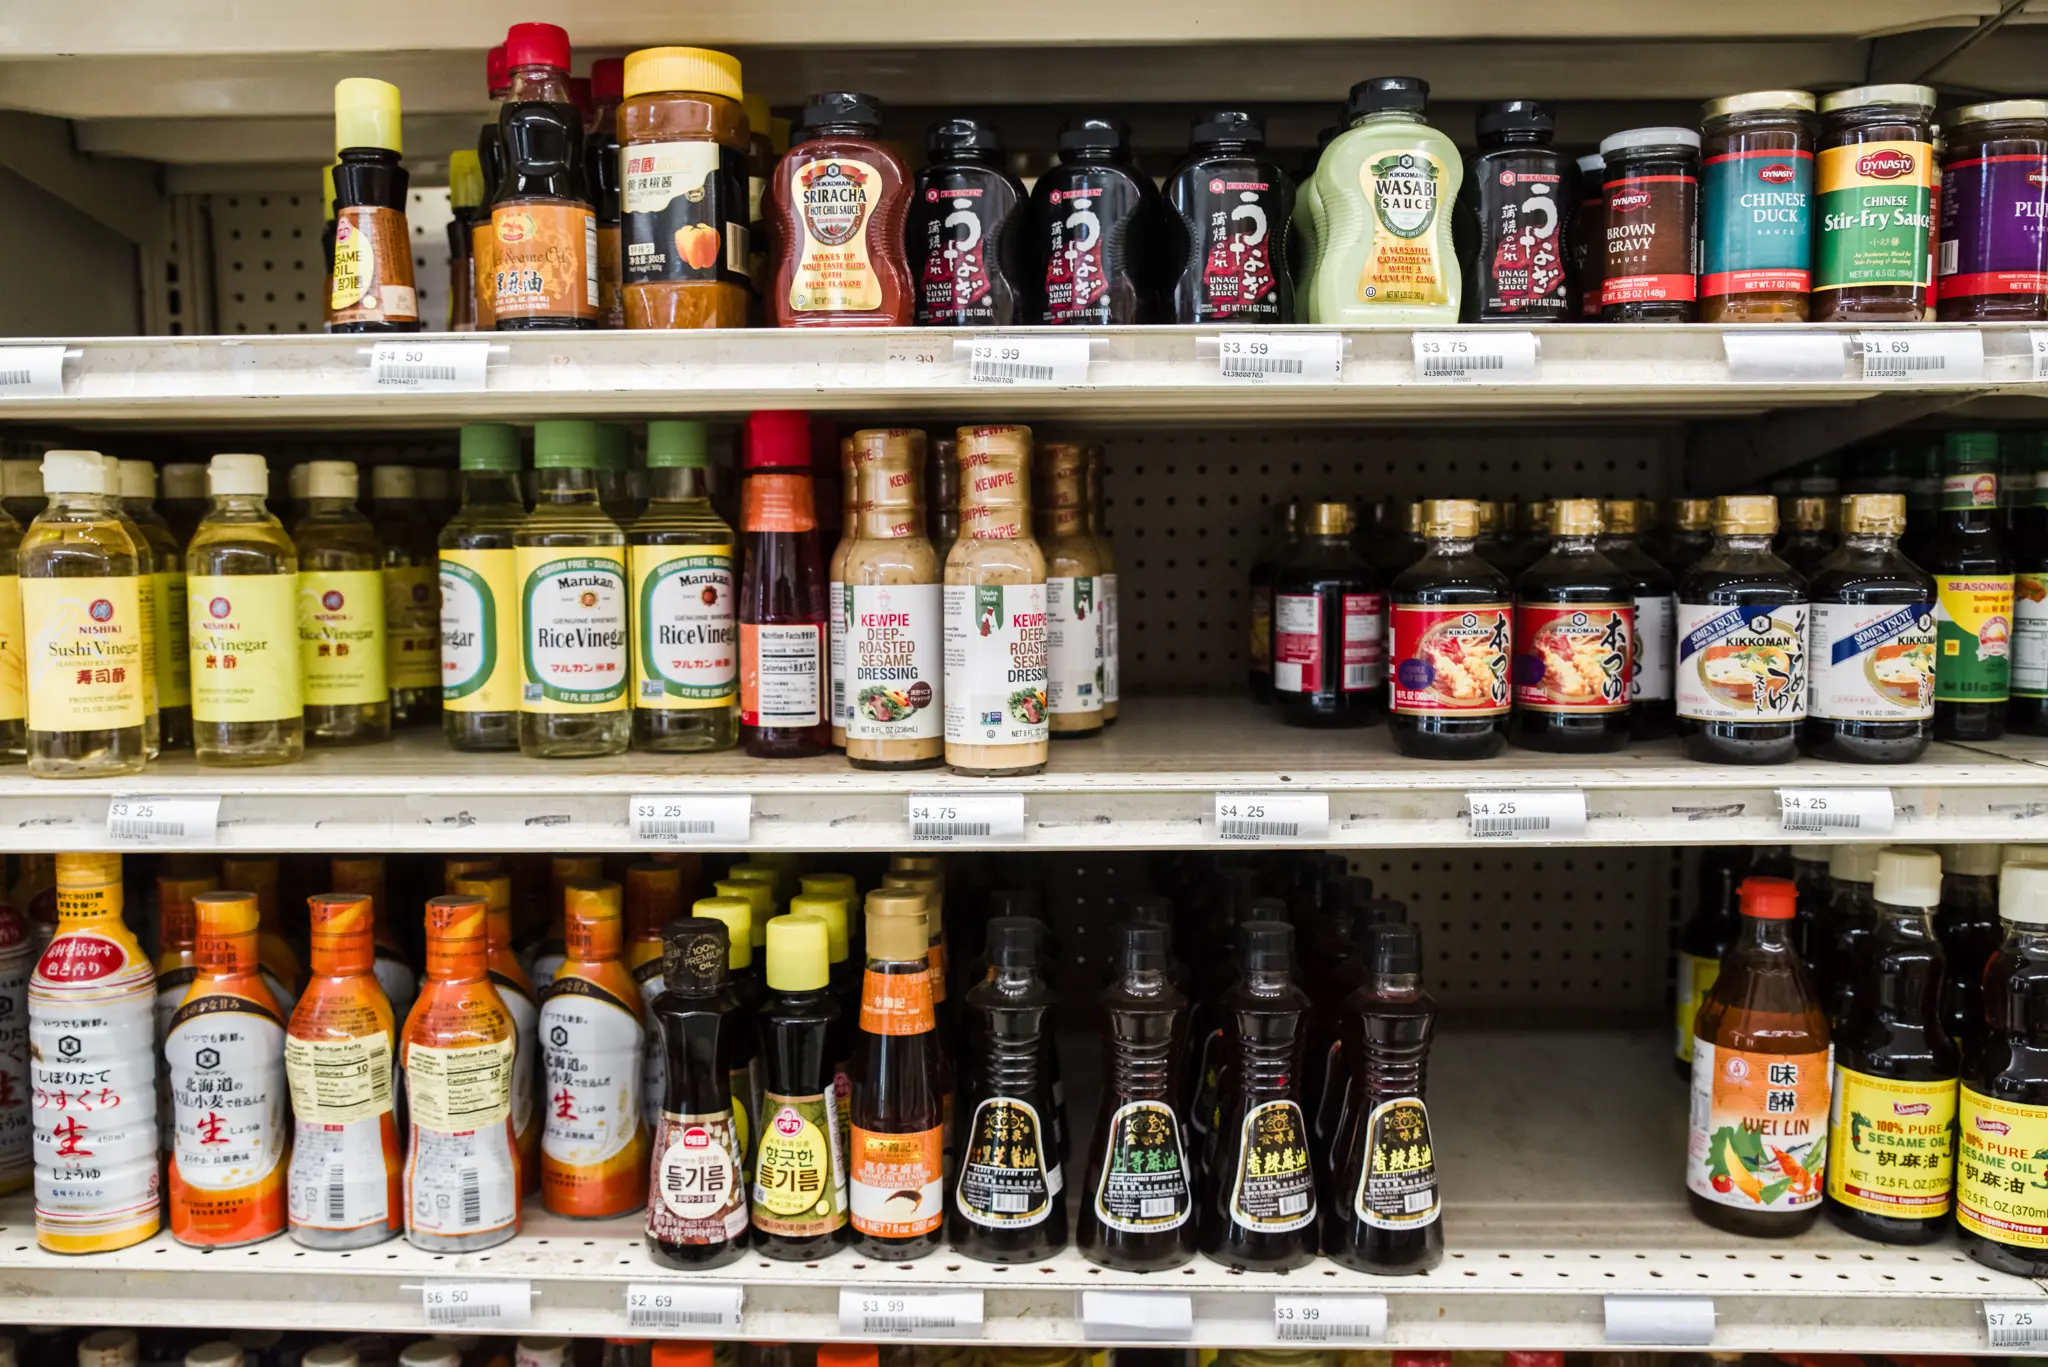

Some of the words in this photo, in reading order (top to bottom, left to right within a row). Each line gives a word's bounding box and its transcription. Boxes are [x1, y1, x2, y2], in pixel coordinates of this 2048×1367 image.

[1862, 159, 1911, 171] DYNASTY
[1762, 170, 1793, 179] DYNASTY
[1226, 182, 1269, 191] KIKKOMAN
[1376, 180, 1437, 197] WASABI
[804, 188, 867, 205] SRIRACHA
[1612, 195, 1648, 207] DYNASTY
[1740, 192, 1806, 208] CHINESE
[1863, 195, 1908, 208] CHINESE
[810, 204, 824, 216] HOT
[823, 203, 838, 215] CHILI
[839, 203, 859, 215] SAUCE
[1382, 198, 1431, 210] SAUCE
[1753, 208, 1798, 223] DUCK
[1824, 209, 1890, 232] Stir-Fry
[1894, 208, 1930, 229] Sauce
[1607, 223, 1656, 240] BROWN
[1608, 237, 1653, 253] GRAVY
[811, 253, 840, 261] WAKES
[1377, 255, 1431, 263] CONDIMENT
[1611, 255, 1647, 264] SAUCE
[1853, 258, 1884, 267] Stir-Frying
[802, 263, 822, 271] YOUR
[823, 262, 844, 270] TASTE
[845, 261, 866, 269] BUDS
[1210, 276, 1238, 284] UNAGI
[1499, 270, 1528, 278] UNAGI
[1849, 271, 1863, 279] NET
[1875, 270, 1887, 278] 6.5
[828, 280, 861, 288] FLAVOR
[926, 283, 952, 291] UNAGI
[1049, 283, 1072, 291] UNAGI
[1745, 281, 1758, 289] NET
[1777, 280, 1785, 288] OZ
[2010, 281, 2021, 290] NET
[1049, 290, 1072, 298] SUSHI
[1617, 290, 1631, 299] 5.25
[1632, 289, 1642, 298] OZ
[1643, 288, 1666, 298] (148g)
[974, 346, 1020, 360] $3.99
[1223, 342, 1268, 355] $3.59
[1422, 341, 1468, 354] $3.75
[1865, 340, 1910, 354] $1.69
[379, 351, 424, 363] $4.50
[972, 375, 1014, 384] 4139000706
[1222, 370, 1264, 379] 4139000703
[975, 472, 1015, 492] KEWPIE
[972, 523, 1018, 540] KEWPIE
[568, 559, 587, 569] FREE
[557, 576, 614, 589] Marukan
[1947, 582, 2009, 592] SEASONING
[980, 589, 999, 597] Shake
[553, 617, 588, 625] GENUINE
[675, 614, 708, 622] GENUINE
[861, 614, 910, 627] KEWPIE
[79, 625, 122, 634] NISHIKI
[1691, 622, 1717, 644] SOMEN
[1714, 608, 1742, 631] TSUYU
[1853, 625, 1885, 646] SOMEN
[1883, 608, 1913, 630] TSUYU
[322, 626, 374, 642] Vinegar
[538, 628, 574, 648] Rice
[659, 624, 695, 645] Rice
[761, 632, 784, 640] Nutrition
[867, 628, 905, 641] DEEP-
[1020, 629, 1046, 642] DEEP-
[210, 636, 268, 653] Vinegar
[858, 641, 916, 655] ROASTED
[1726, 637, 1790, 647] KIKKOMAN
[49, 641, 91, 657] Sushi
[93, 640, 138, 658] Vinegar
[550, 663, 592, 672] マルカン
[672, 659, 713, 669] マルカン
[861, 654, 914, 668] SESAME
[77, 667, 125, 685] 寿司酢
[857, 667, 920, 682] DRESSING
[860, 727, 871, 735] NET
[1011, 730, 1022, 739] NET
[1472, 802, 1517, 815] $4.25
[1784, 797, 1828, 810] $4.25
[912, 807, 957, 819] $4.75
[1220, 805, 1265, 818] $4.25
[1219, 833, 1260, 841] 4139002202
[1473, 830, 1513, 838] 4139002202
[691, 943, 716, 955] 100%
[684, 946, 726, 967] PREMIUM
[46, 963, 101, 977] 色と香り
[699, 962, 716, 971] OIL
[447, 1052, 478, 1061] Nutrition
[479, 1048, 498, 1057] Facts
[314, 1069, 344, 1077] Calories
[356, 1063, 369, 1074] 10
[38, 1068, 112, 1086] しぼりたて
[447, 1076, 478, 1085] Calories
[186, 1077, 243, 1094] 北海道の
[35, 1087, 121, 1112] うすくち
[554, 1087, 579, 1120] 生
[196, 1112, 230, 1145] 生
[229, 1123, 260, 1135] しょうゆ
[1743, 1117, 1778, 1136] WEI
[1783, 1118, 1810, 1136] LIN
[1876, 1120, 1904, 1134] 100%
[1908, 1123, 1943, 1135] PURE
[53, 1115, 93, 1158] 生
[1868, 1132, 1926, 1148] SESAME
[1929, 1136, 1946, 1147] OIL
[766, 1145, 815, 1168] 향긋한
[1987, 1142, 2029, 1160] PURE
[1875, 1150, 1940, 1169] 胡麻油
[1962, 1143, 2007, 1170] SESAME
[2010, 1161, 2038, 1174] OIL
[52, 1167, 101, 1182] しょうゆ
[666, 1165, 726, 1192] 들기름
[760, 1164, 820, 1192] 들기름
[1849, 1169, 1872, 1184] NET.
[1875, 1175, 1896, 1188] 12.5
[1965, 1162, 2026, 1195] 胡麻油
[1964, 1189, 1979, 1204] 12.5
[1989, 1312, 2033, 1326] $7.25
